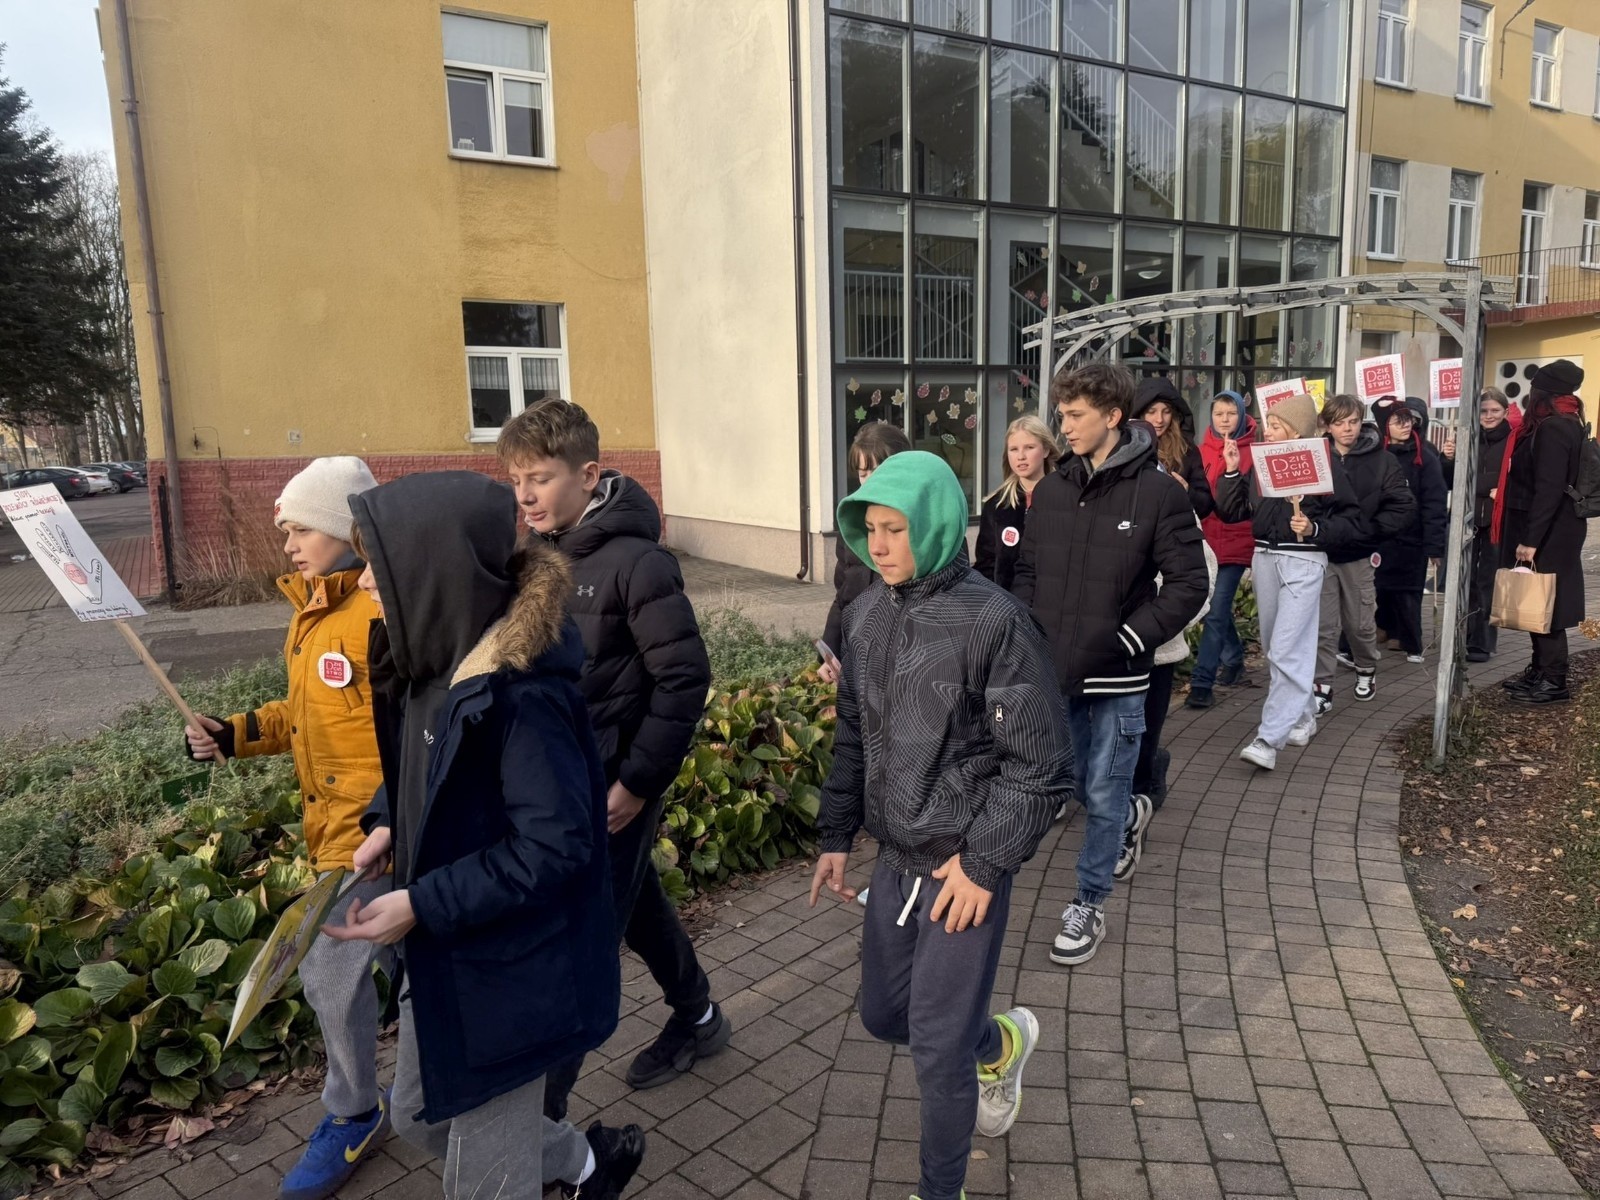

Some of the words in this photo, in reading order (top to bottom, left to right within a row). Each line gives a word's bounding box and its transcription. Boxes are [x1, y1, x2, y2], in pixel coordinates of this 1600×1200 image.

[1367, 380, 1392, 389] STWO
[1263, 447, 1295, 455] UDZIAŁ
[1275, 468, 1312, 480] STWO
